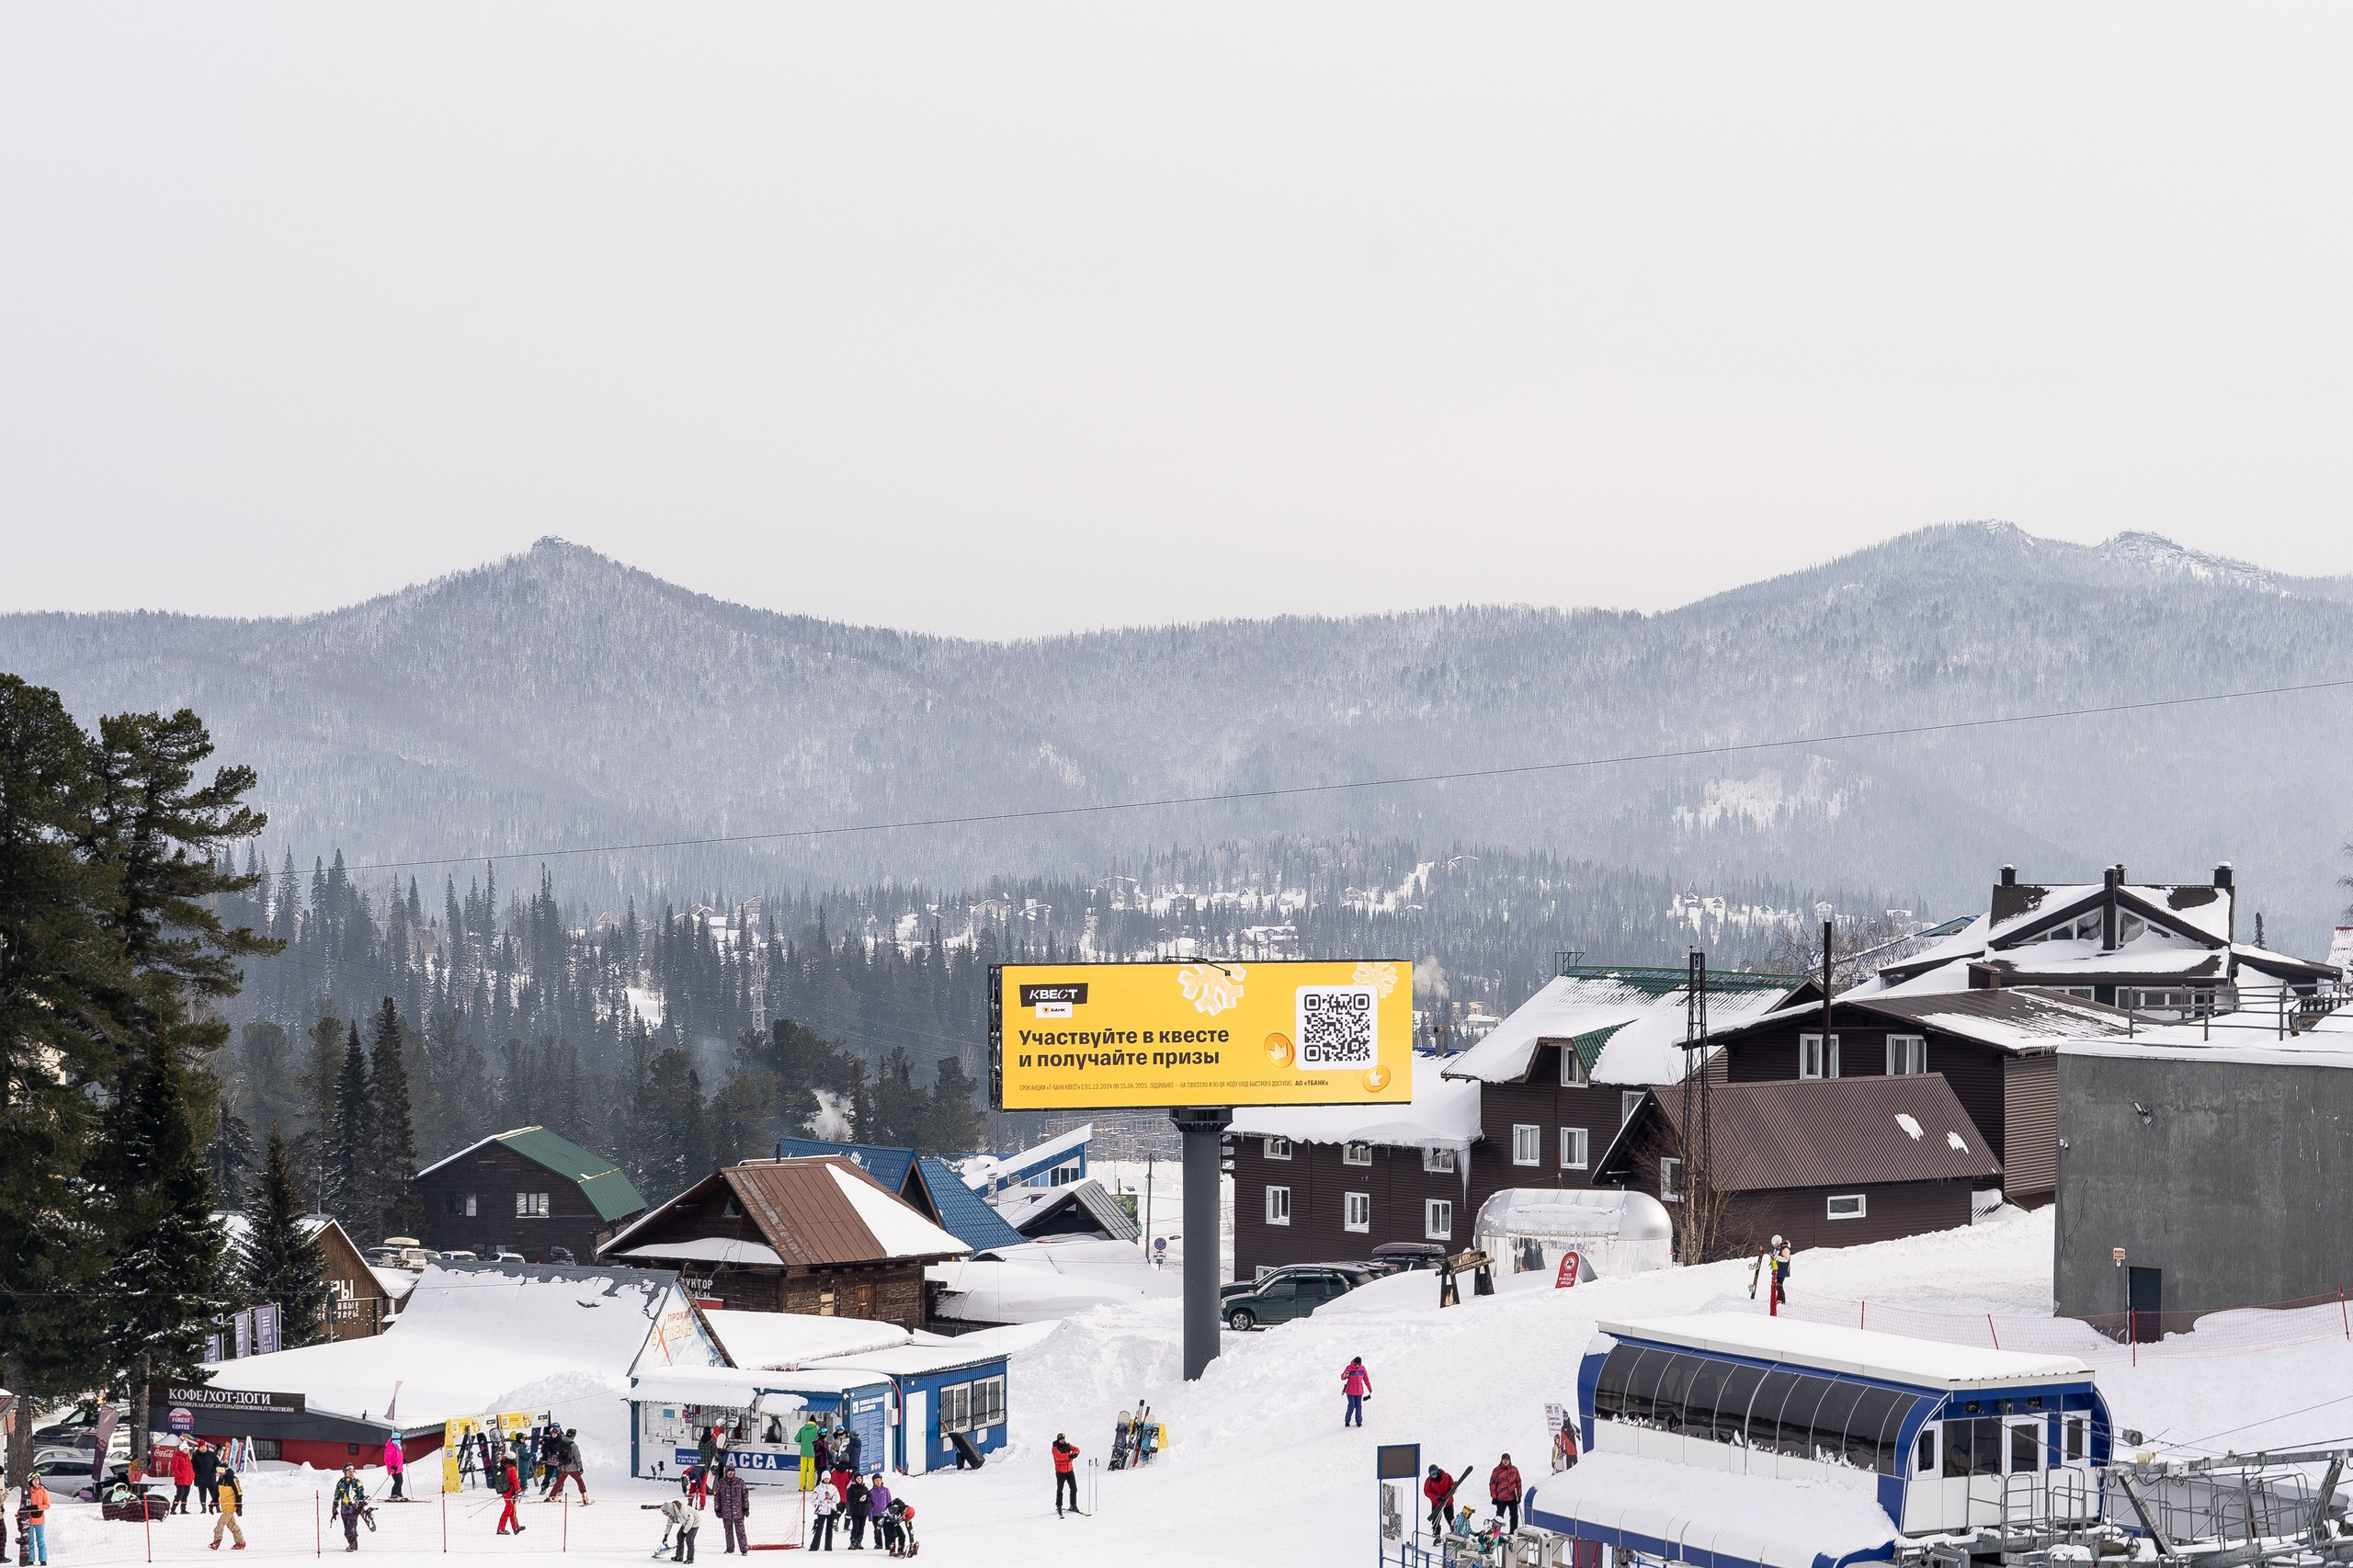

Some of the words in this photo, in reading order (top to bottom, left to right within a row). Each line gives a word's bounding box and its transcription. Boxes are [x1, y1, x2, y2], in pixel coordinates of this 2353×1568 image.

[1029, 989, 1078, 1000] КВЕСТ
[1018, 1028, 1138, 1049] Участвуйте
[1142, 1031, 1154, 1043] в
[1159, 1029, 1230, 1043] квесте
[1018, 1054, 1031, 1067] и
[1037, 1049, 1148, 1070] получайте
[1153, 1051, 1220, 1068] призы
[682, 1278, 713, 1290] УКТОР
[668, 1310, 691, 1323] ПРОКАТ
[168, 1388, 271, 1405] КОФЕ/ХОТ-ДОГИ
[726, 1452, 778, 1470] АССА
